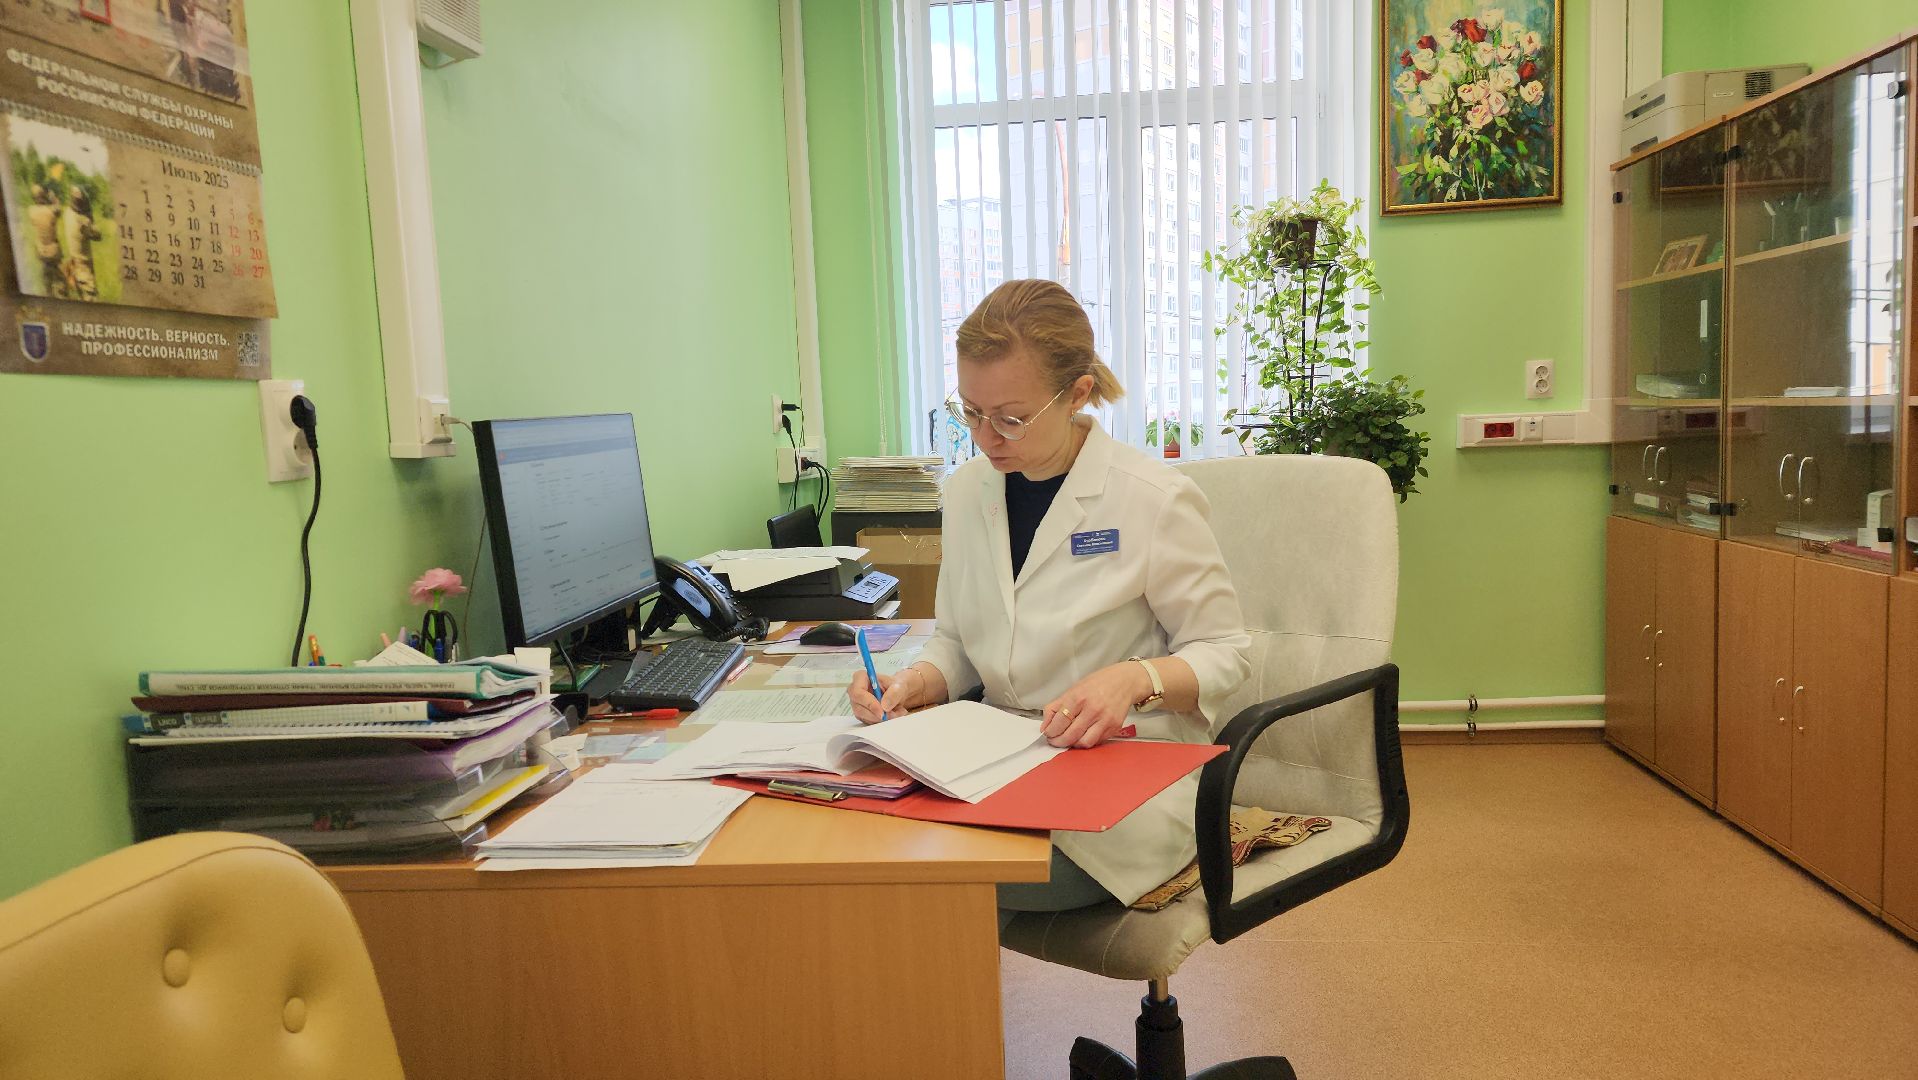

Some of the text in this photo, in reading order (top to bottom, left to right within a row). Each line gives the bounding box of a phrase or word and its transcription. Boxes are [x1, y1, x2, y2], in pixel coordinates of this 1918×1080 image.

[6, 47, 234, 130] ФЕДЕРАЛЬНОЙ СЛУЖБЫ ОХРАНЫ
[36, 75, 215, 140] РОССИЙСКОЙ ФЕДЕРАЦИИ
[162, 161, 229, 188] Июль 2025
[119, 203, 128, 217] 7
[145, 209, 152, 222] 8
[168, 213, 175, 226] 9
[187, 217, 200, 231] 10
[210, 222, 220, 235] 11
[249, 229, 260, 241] 13
[143, 189, 149, 204] 1
[166, 194, 173, 209] 2
[189, 199, 195, 213] 3
[210, 204, 216, 217] 4
[248, 213, 255, 224] 6
[119, 225, 134, 240] 14
[144, 229, 158, 244] 15
[168, 233, 181, 248] 16
[190, 237, 201, 250] 17
[211, 241, 223, 254] 18
[250, 248, 262, 260] 20
[123, 245, 135, 261] 21
[146, 249, 160, 264] 22
[170, 253, 182, 268] 23
[192, 256, 204, 270] 24
[213, 259, 224, 273] 25
[252, 265, 264, 278] 27
[123, 265, 206, 289] 28 29 30 31
[62, 321, 163, 342] НАДЕЖНОСТЬ.
[81, 341, 218, 361] ПРОФЕССИОНАЛИЗМ
